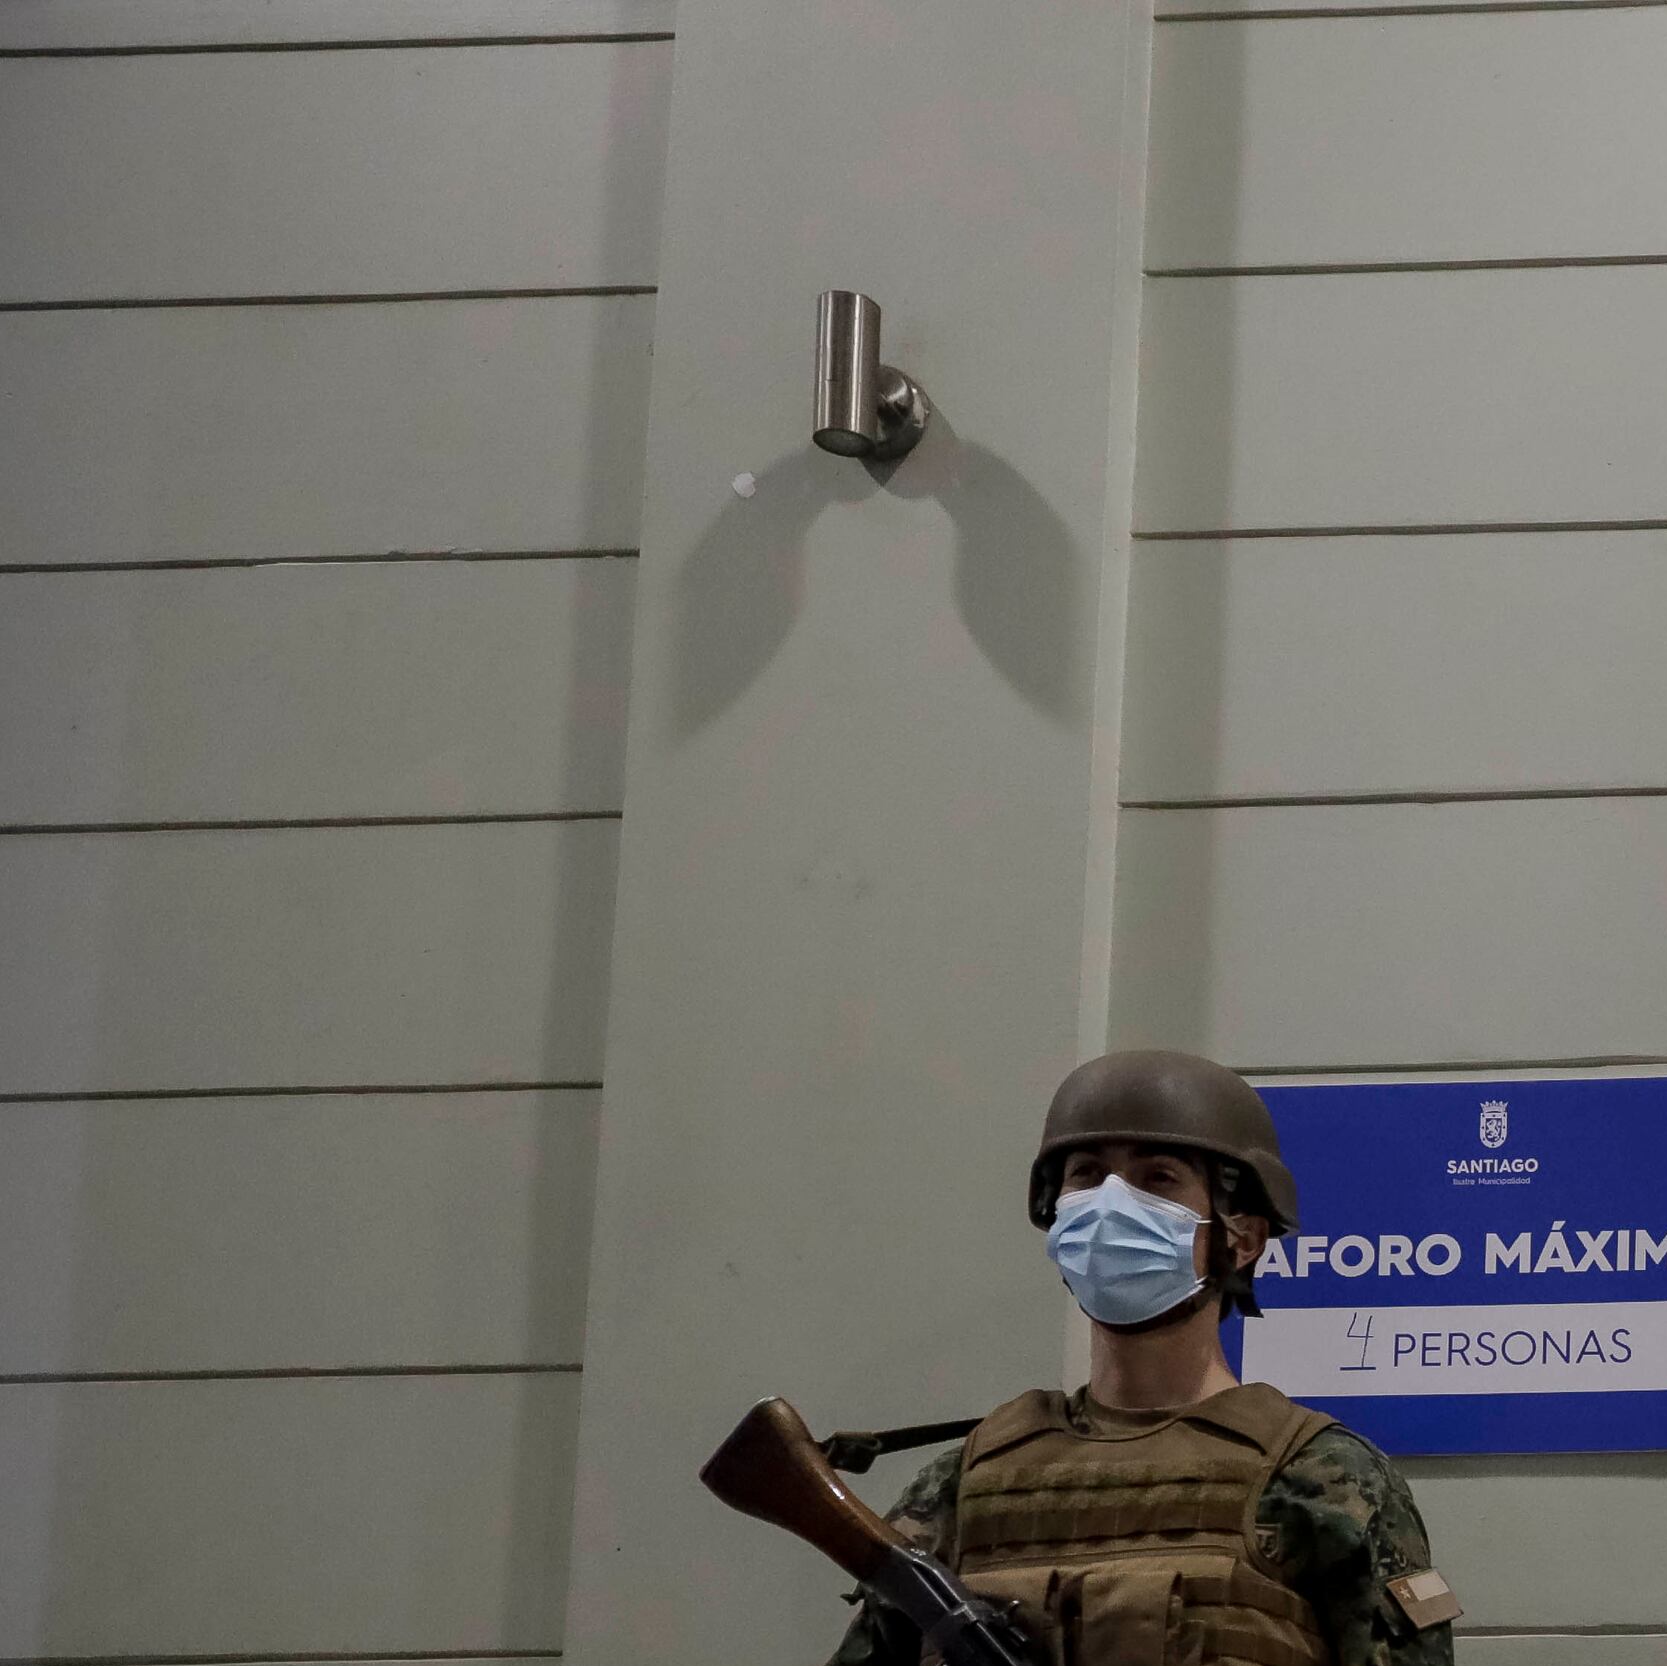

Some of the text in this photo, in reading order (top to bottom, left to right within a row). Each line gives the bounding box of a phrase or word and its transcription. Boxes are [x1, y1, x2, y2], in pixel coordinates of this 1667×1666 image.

[1447, 1158, 1539, 1174] SANTIAGO
[1479, 1177, 1531, 1186] Municipalidad
[1253, 1233, 1462, 1278] AFORO
[1345, 1312, 1632, 1368] 4 PERSONAS
